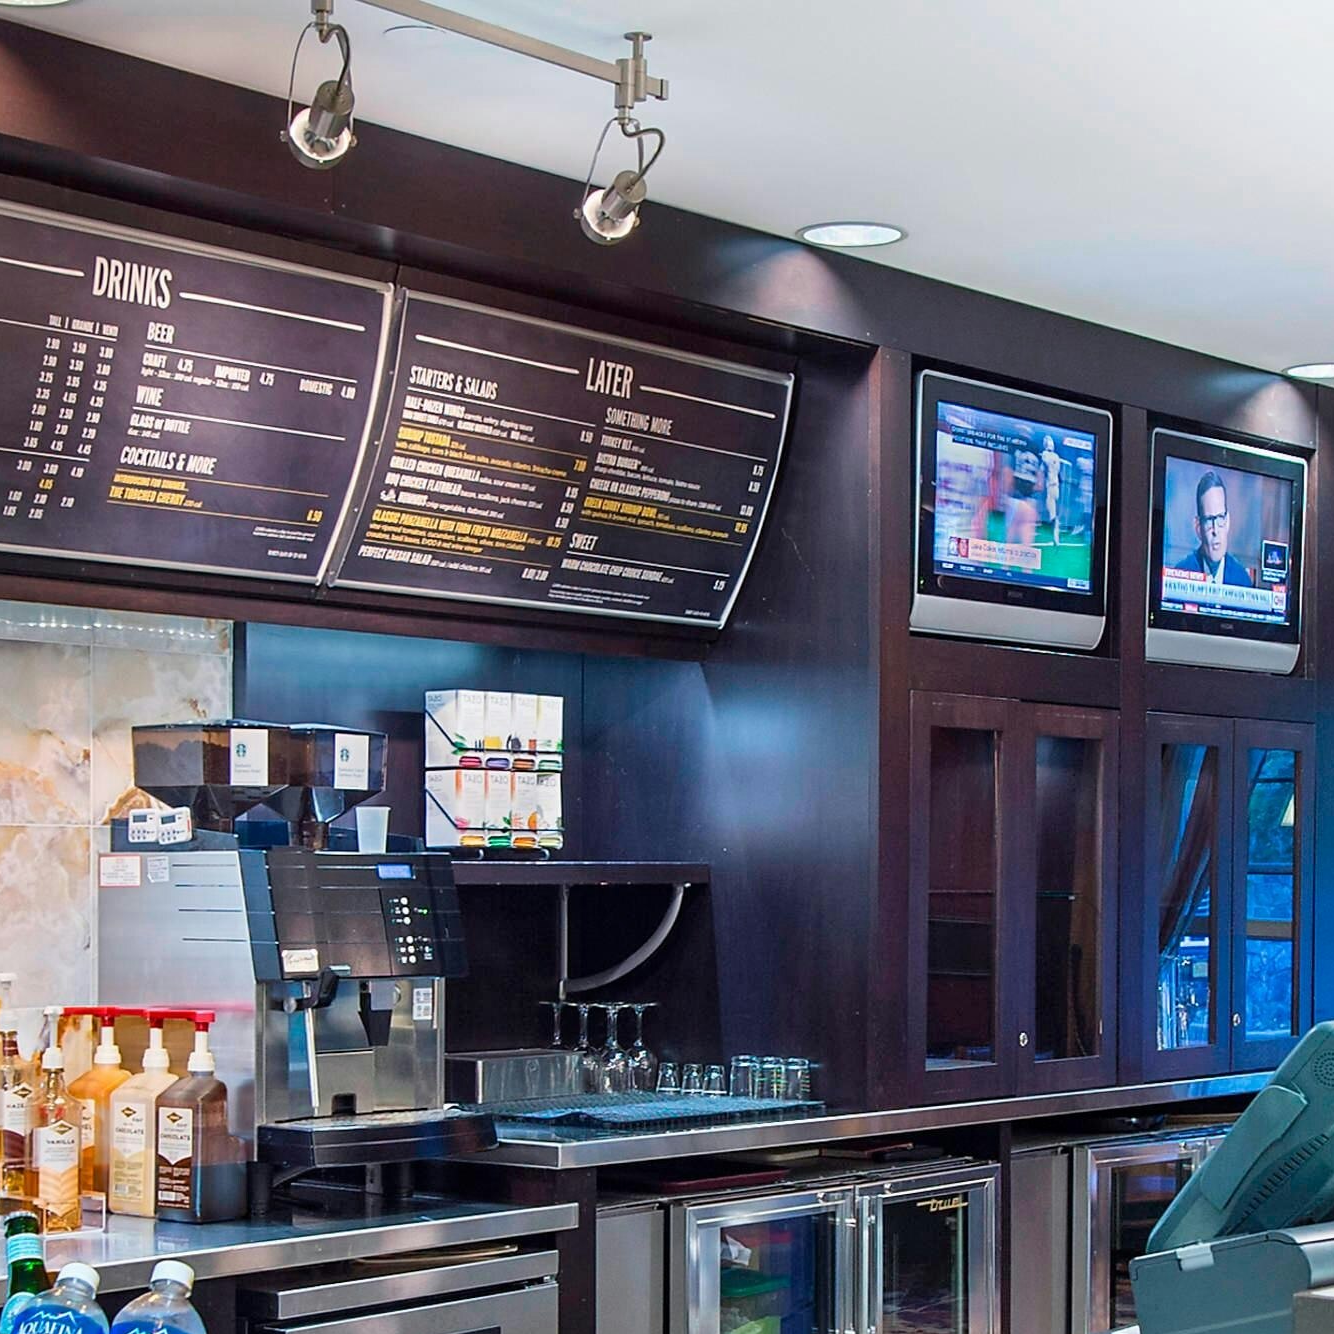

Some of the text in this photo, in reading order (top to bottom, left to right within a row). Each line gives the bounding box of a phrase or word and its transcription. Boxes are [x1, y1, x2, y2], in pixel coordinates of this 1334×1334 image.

[92, 255, 172, 309] DRINKS
[146, 323, 174, 342] BEER
[409, 366, 455, 390] STARTERS
[463, 378, 499, 399] SALADS
[585, 357, 634, 400] LATER
[134, 386, 163, 405] WINE
[129, 414, 154, 428] GLASS
[605, 408, 673, 434] SOMETHING MORE
[120, 447, 175, 468] COCKTAILS
[186, 456, 216, 474] MORE
[569, 534, 597, 550] SWEET
